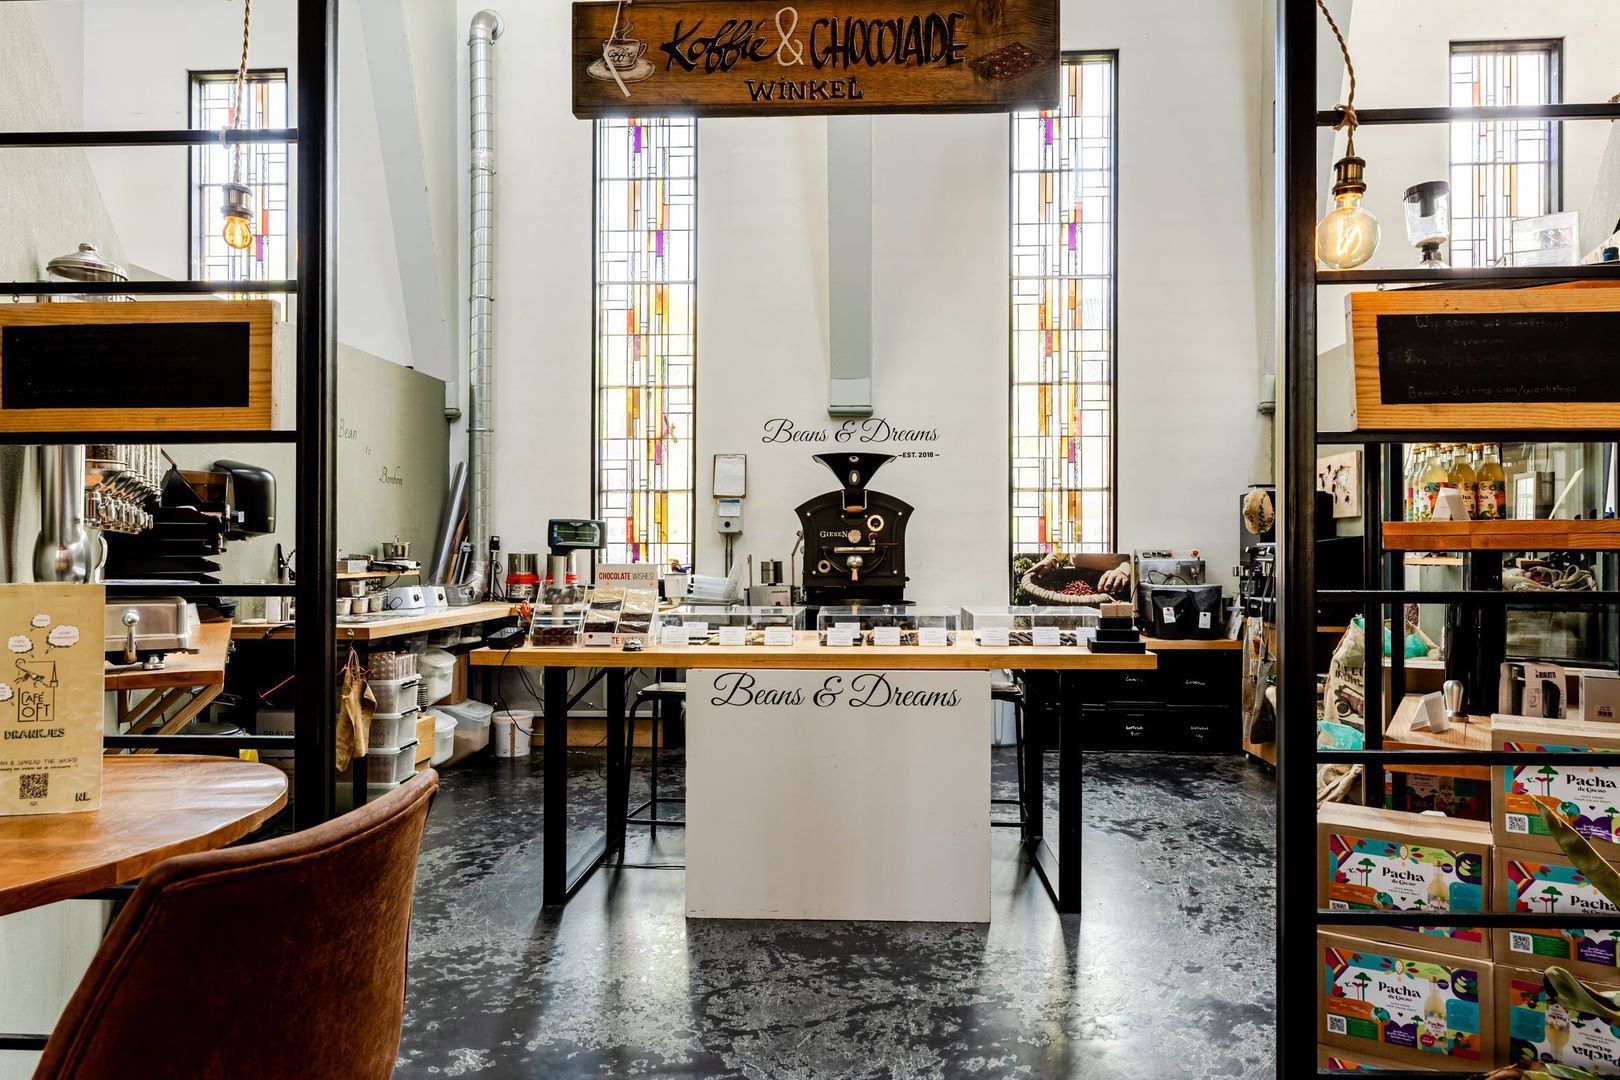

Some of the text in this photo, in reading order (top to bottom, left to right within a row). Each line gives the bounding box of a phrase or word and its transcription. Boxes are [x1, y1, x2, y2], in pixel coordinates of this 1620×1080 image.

[775, 7, 806, 67] &
[808, 12, 968, 70] CHOCOLADE
[338, 418, 357, 440] Bean
[762, 417, 940, 443] Beans & Dreams
[819, 530, 848, 538] GIESEN
[598, 572, 631, 580] CHOCOLATE
[21, 690, 45, 706] CAFÉ
[711, 672, 961, 708] Beans & Dreams
[4, 728, 65, 739] DRANKJES
[1566, 774, 1617, 788] Pacha
[75, 792, 90, 801] NL
[1382, 866, 1425, 883] Pacha
[1378, 981, 1421, 999] Pacha
